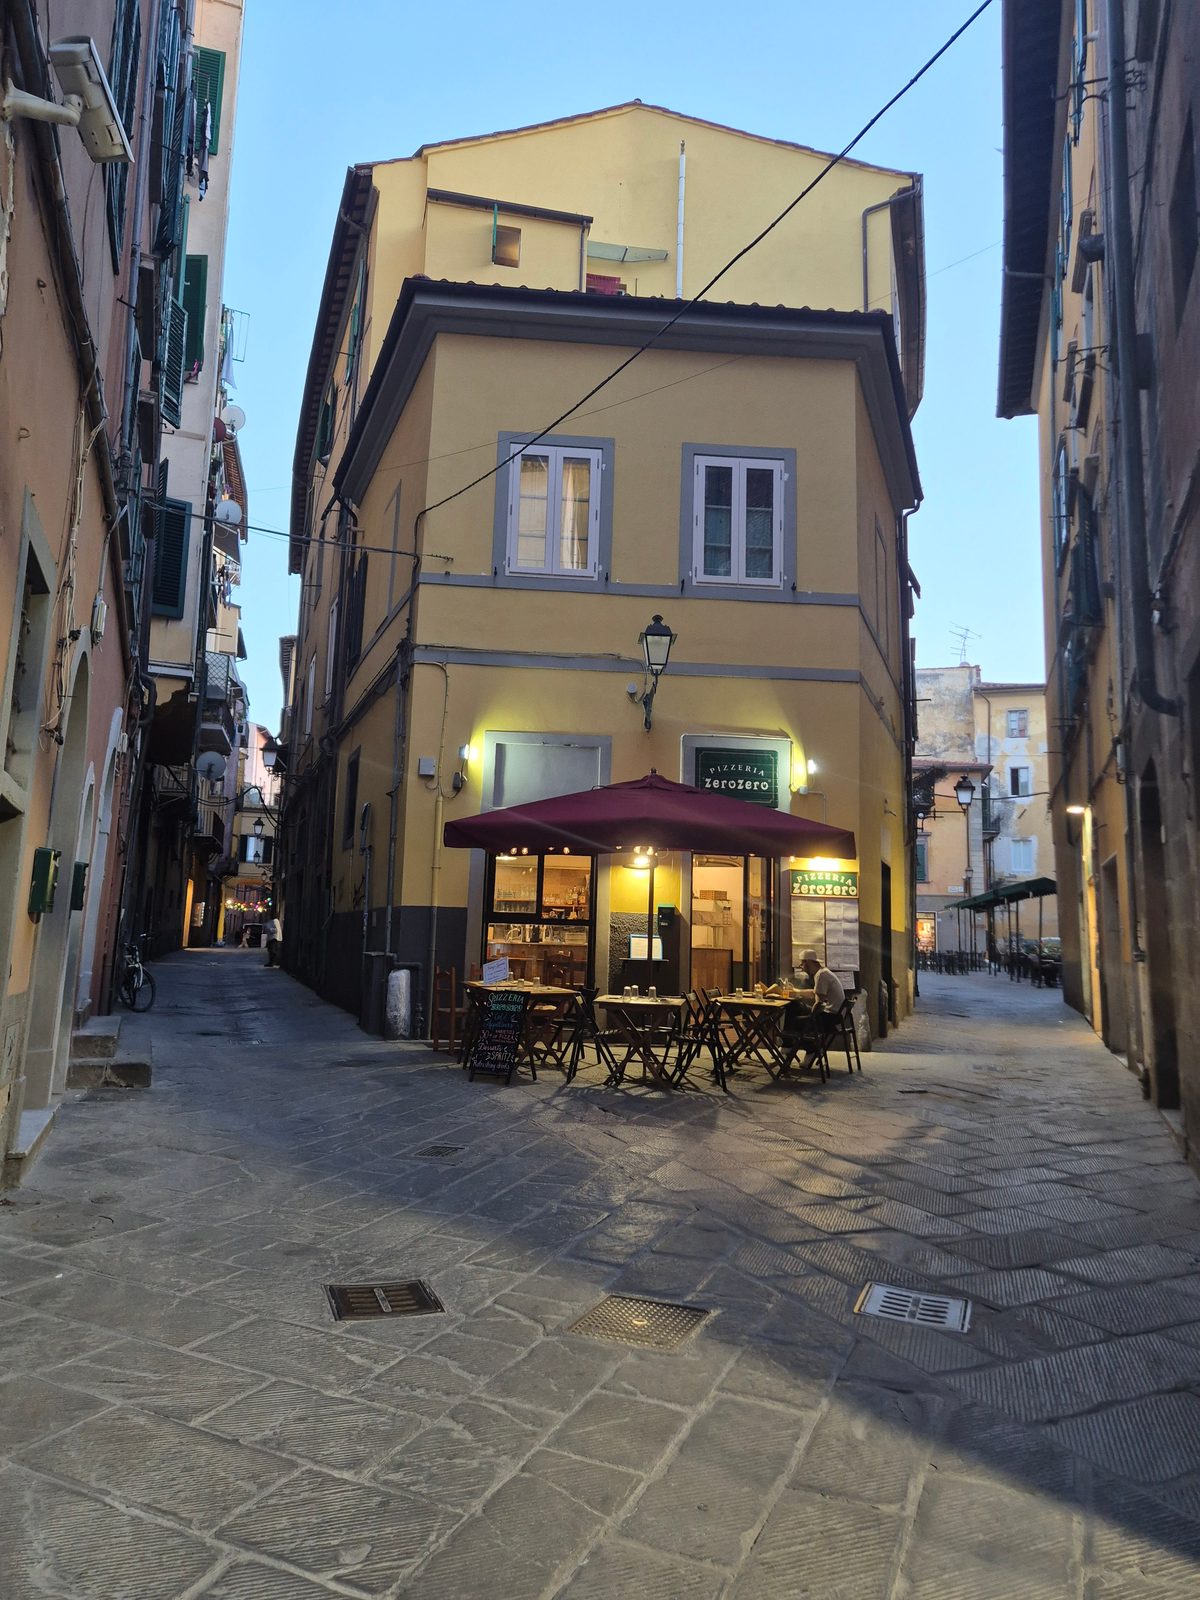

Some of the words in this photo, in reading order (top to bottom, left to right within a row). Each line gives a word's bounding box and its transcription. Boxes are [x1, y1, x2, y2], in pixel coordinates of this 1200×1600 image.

[709, 764, 764, 777] PIZZERIA
[796, 872, 852, 886] PIZZERIA
[487, 992, 525, 1007] PIZZERIA
[490, 1051, 512, 1062] SPRITZ
